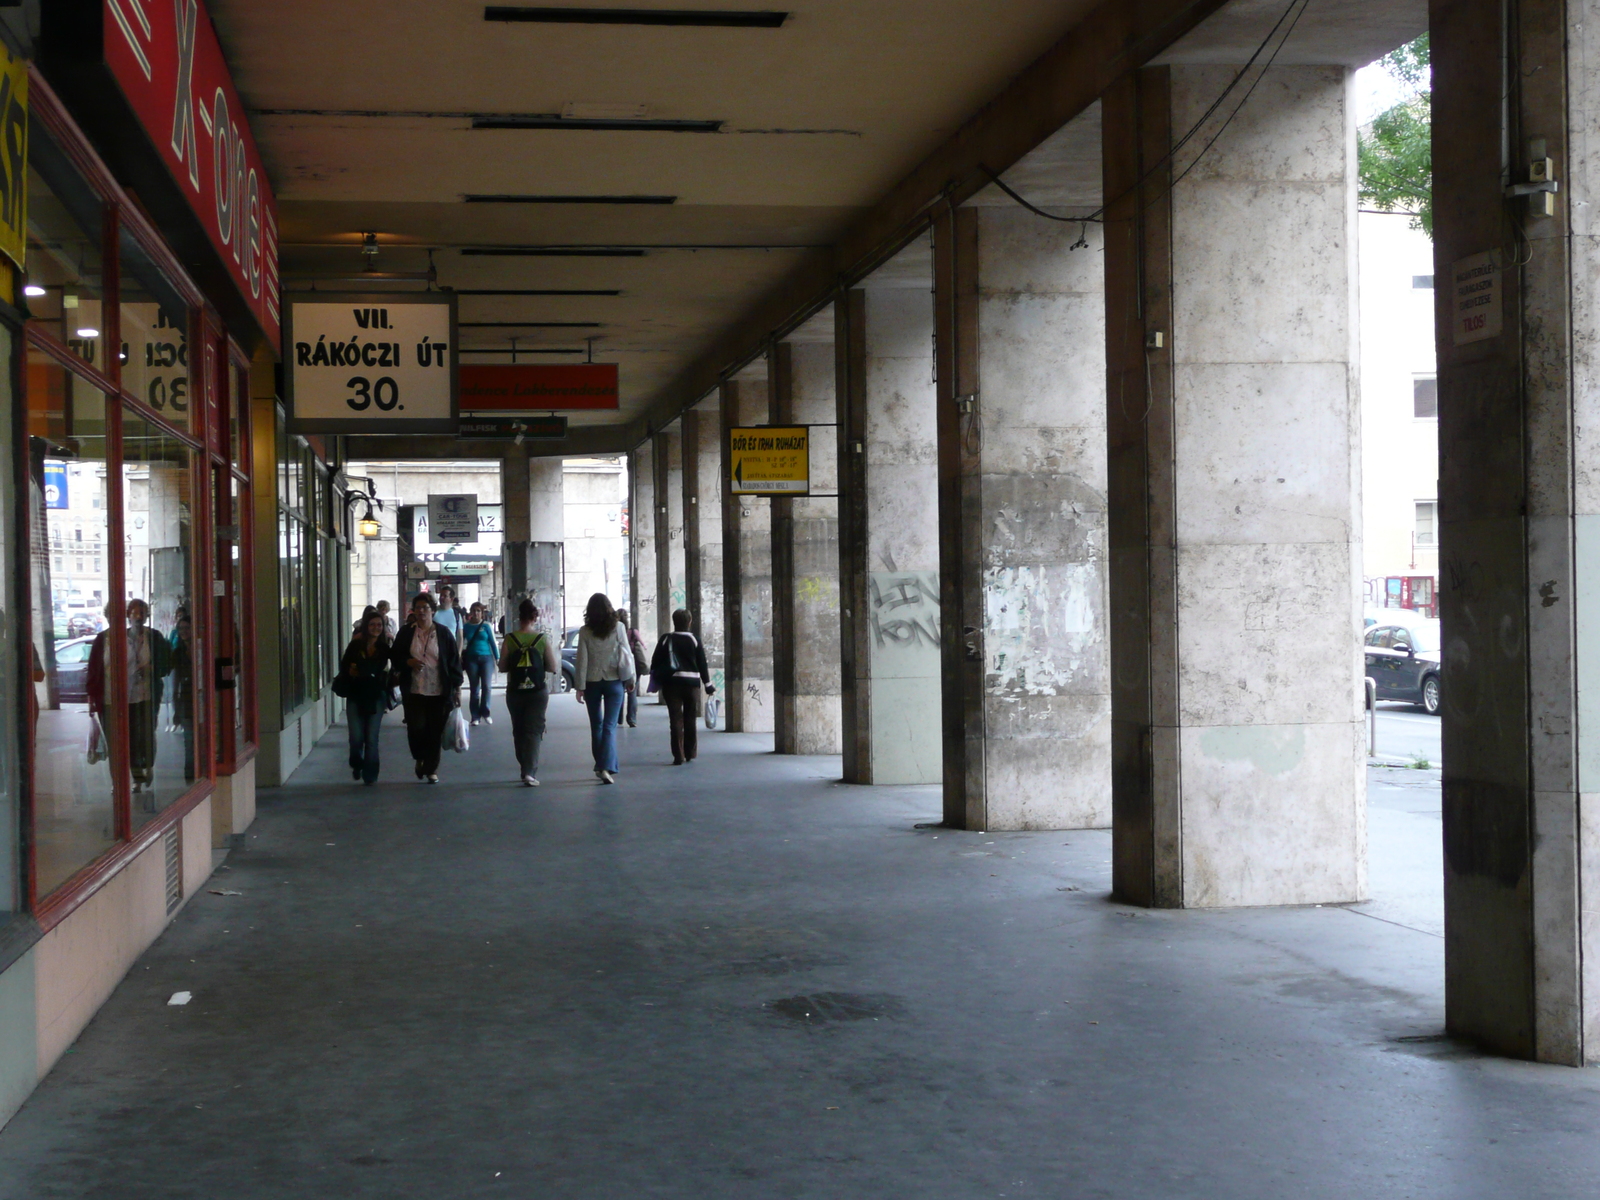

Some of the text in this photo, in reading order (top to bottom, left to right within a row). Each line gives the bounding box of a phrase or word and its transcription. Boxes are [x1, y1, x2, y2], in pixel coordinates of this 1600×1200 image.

[353, 309, 394, 329] VII.
[1463, 313, 1487, 333] TILOS!
[296, 335, 447, 367] RÁKÓCZI ÚT
[346, 376, 405, 411] 30.
[459, 423, 498, 432] NILFISK
[748, 435, 757, 450] ÉS
[758, 437, 774, 451] IRHA
[775, 435, 806, 450] RUHÁZAT
